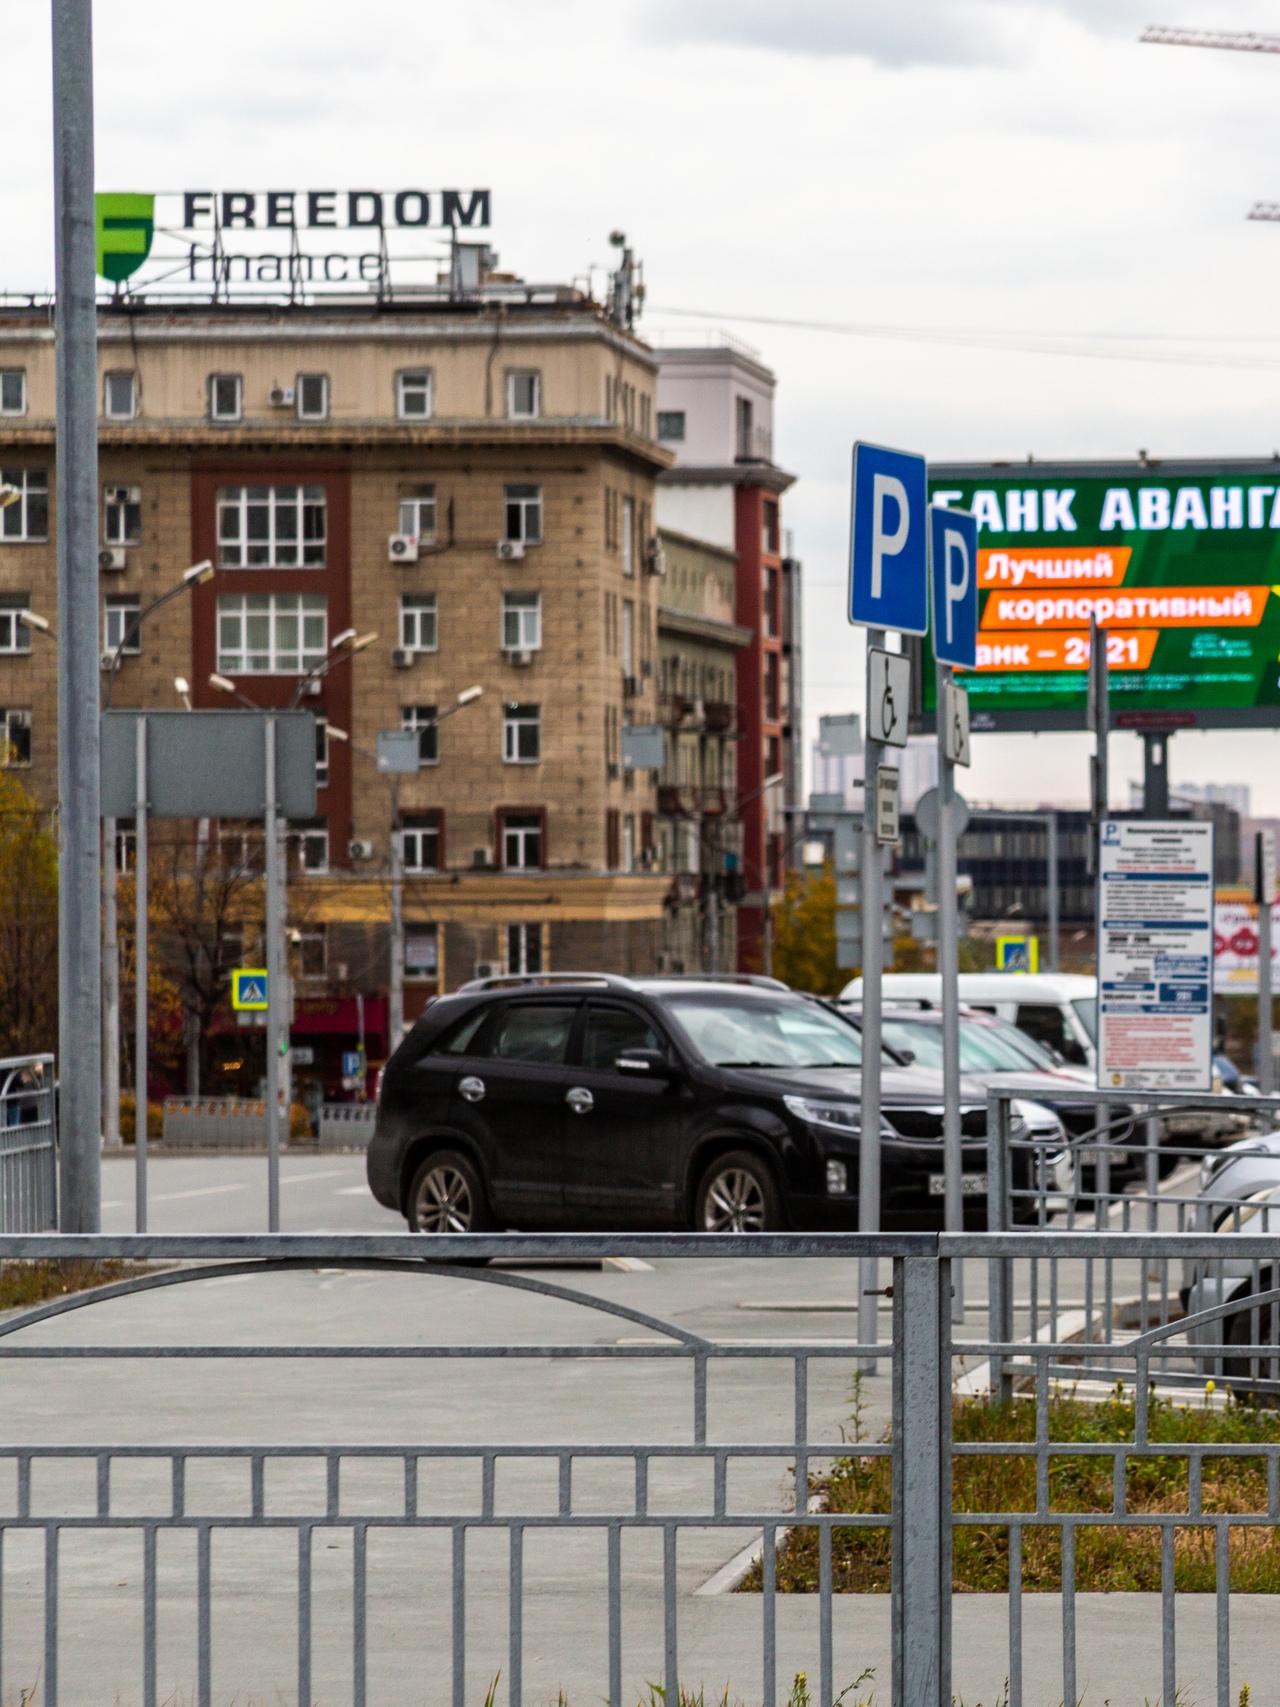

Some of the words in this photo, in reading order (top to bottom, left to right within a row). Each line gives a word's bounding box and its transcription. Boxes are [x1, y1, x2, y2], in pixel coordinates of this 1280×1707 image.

[183, 190, 492, 229] FREEDOM
[189, 242, 385, 282] finance
[983, 552, 1115, 586] Лучший
[998, 589, 1254, 625] корпоративный
[975, 643, 1031, 666] анк
[1063, 636, 1139, 665] 221
